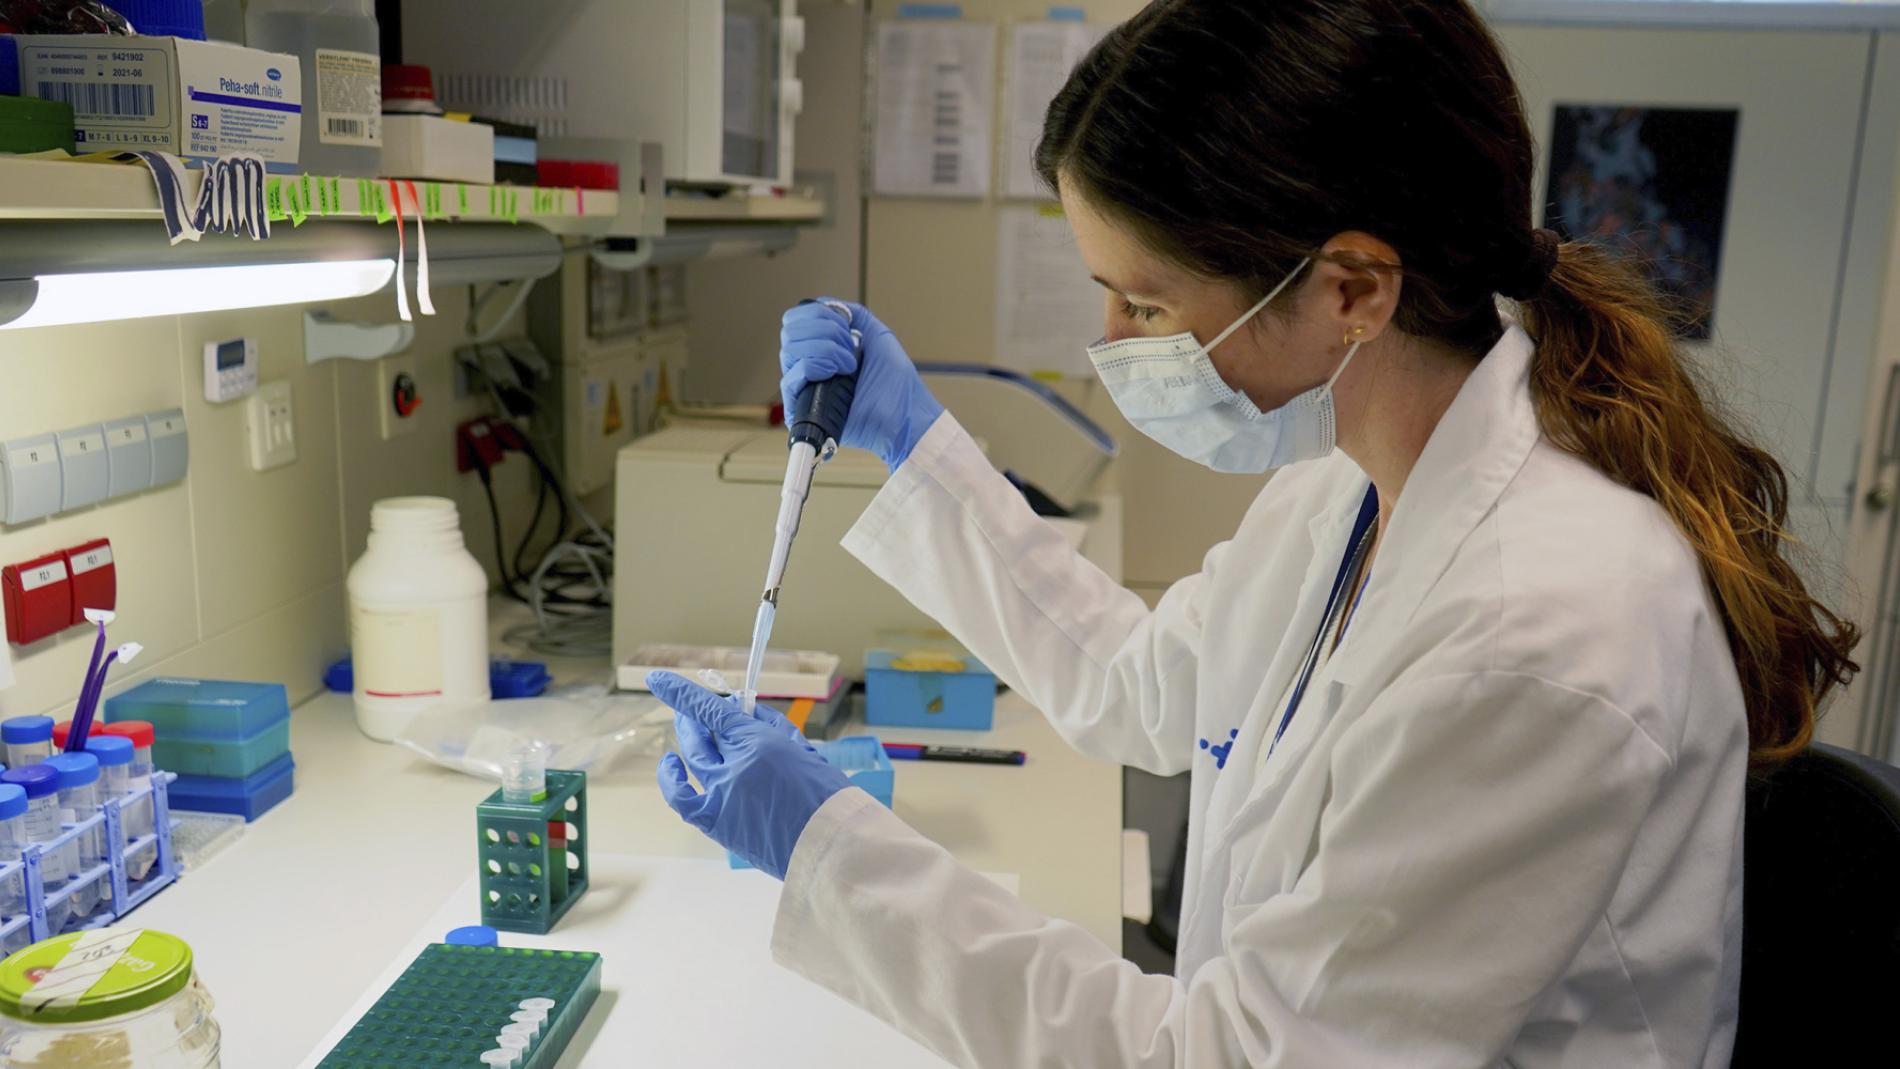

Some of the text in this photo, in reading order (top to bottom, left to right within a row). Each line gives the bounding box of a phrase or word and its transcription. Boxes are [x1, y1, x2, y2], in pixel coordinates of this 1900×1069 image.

[113, 68, 143, 77] 2021-06
[220, 77, 282, 98] Peha-soft nitrile
